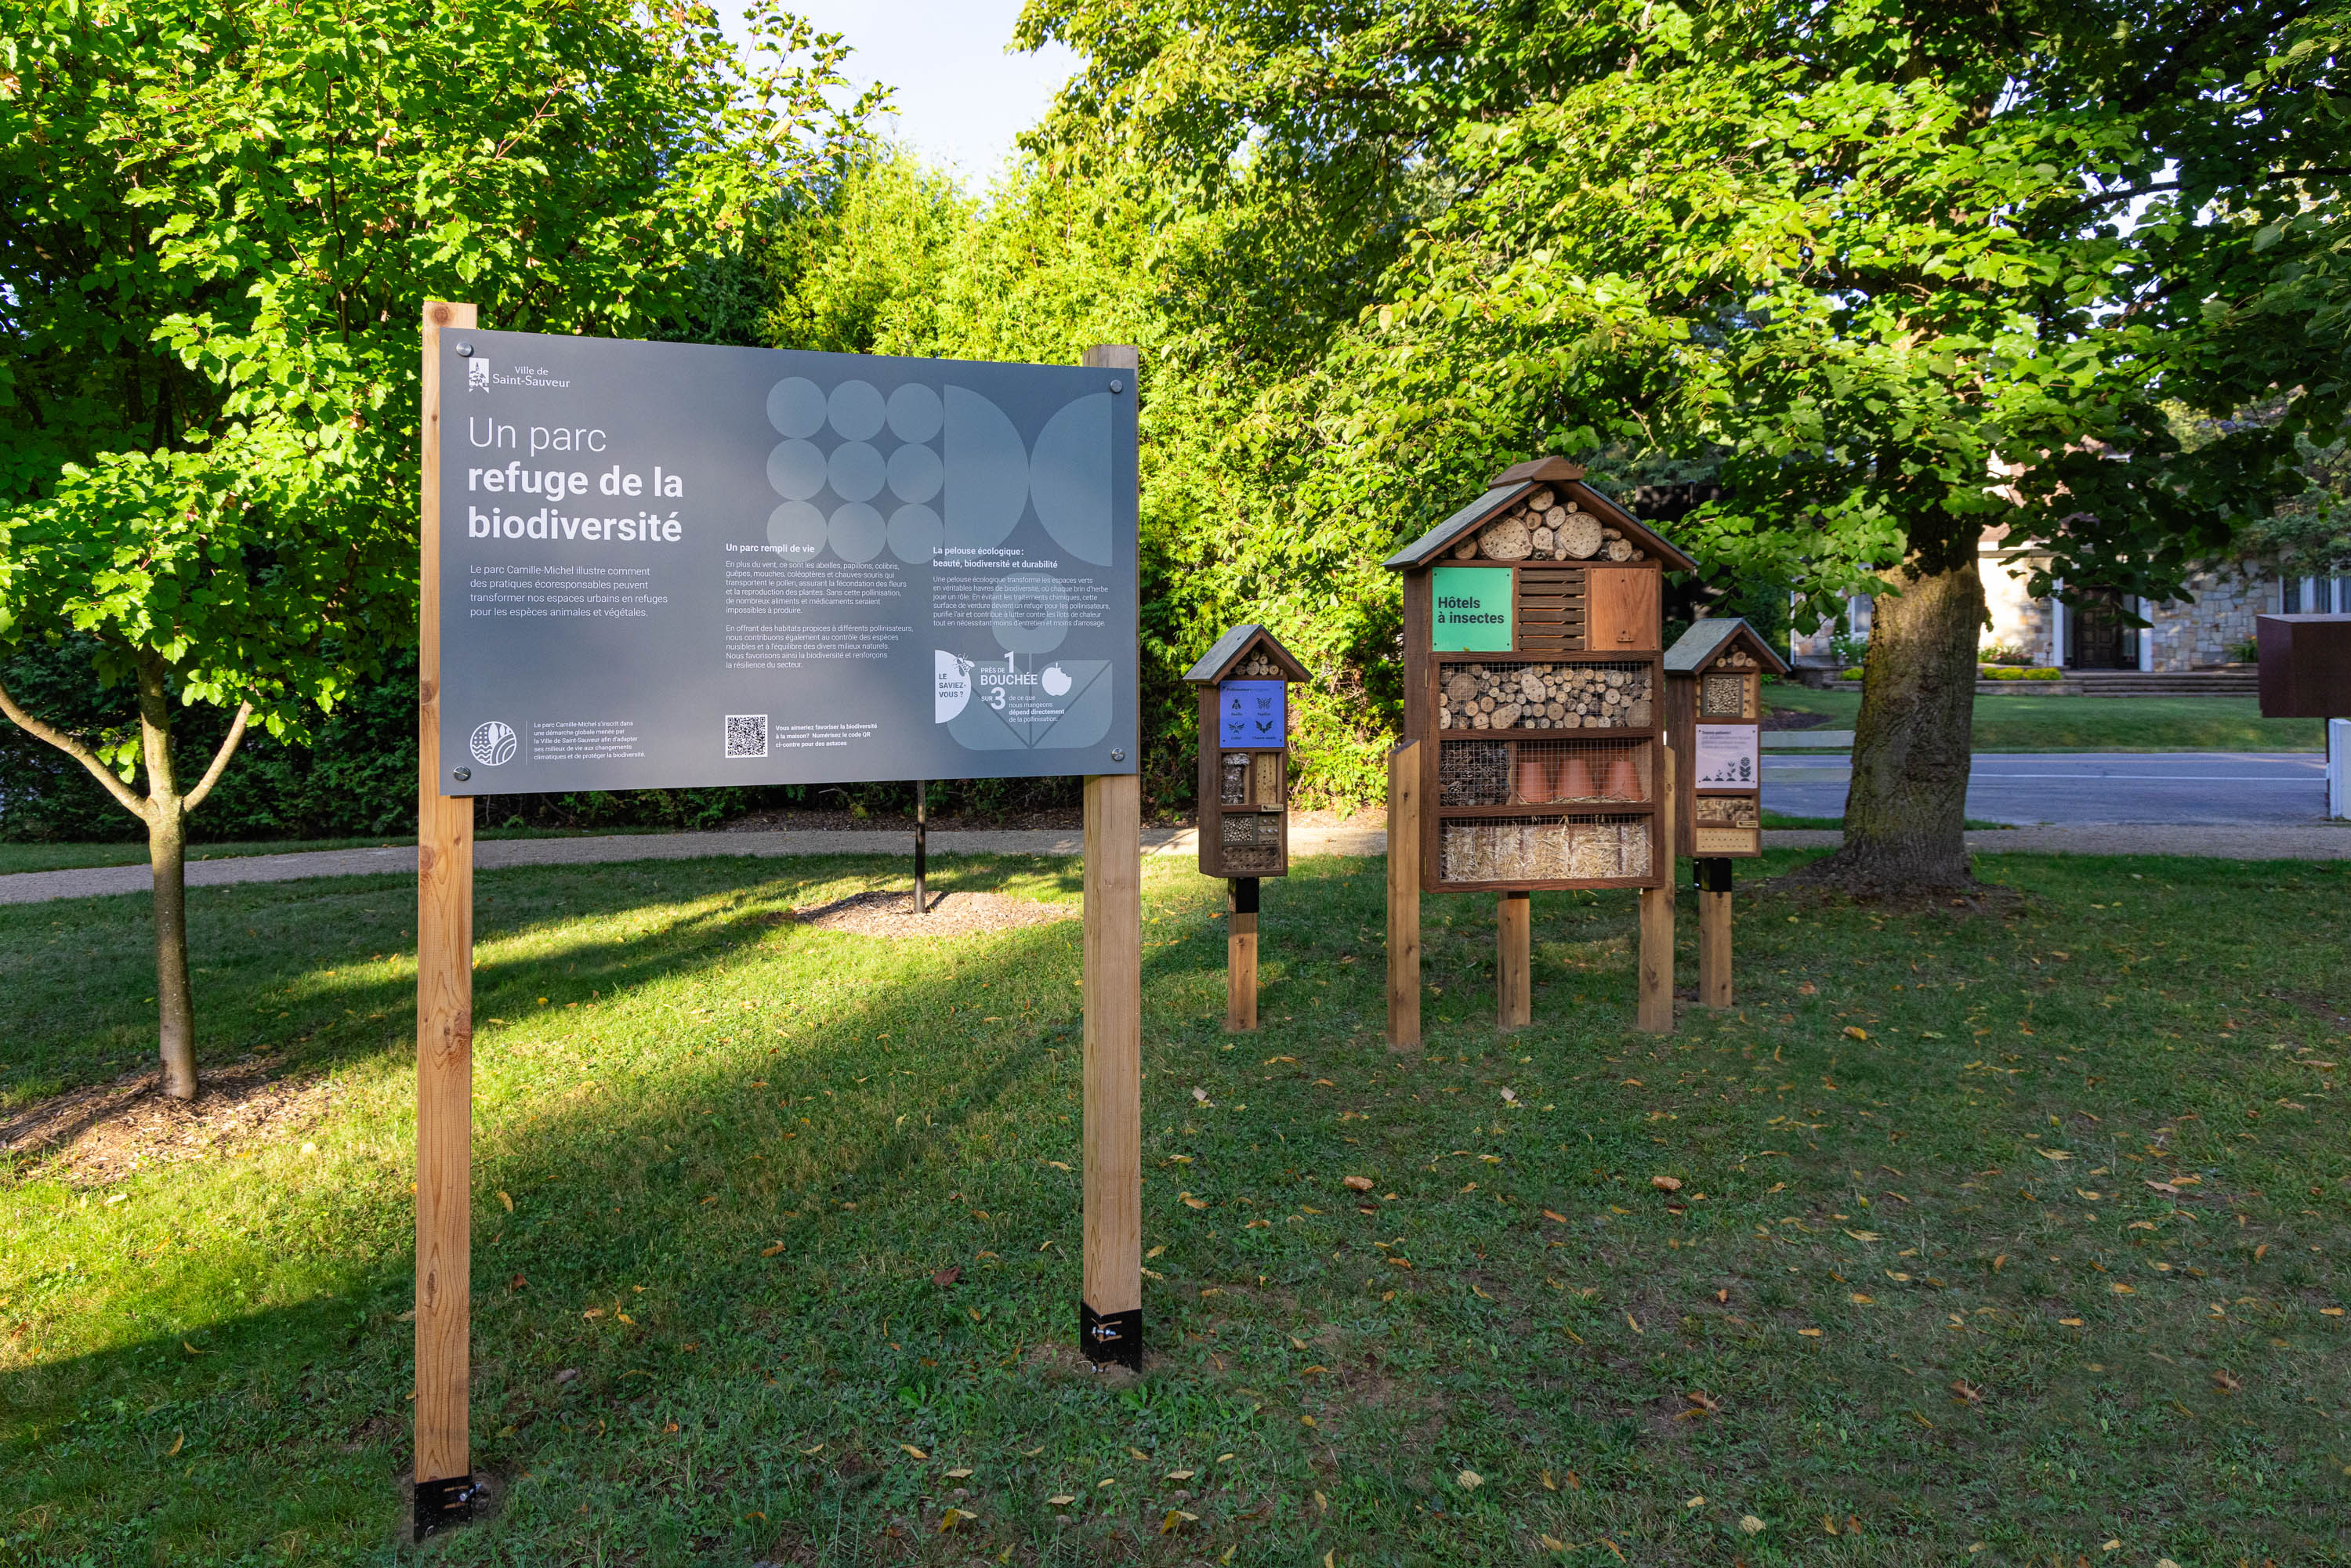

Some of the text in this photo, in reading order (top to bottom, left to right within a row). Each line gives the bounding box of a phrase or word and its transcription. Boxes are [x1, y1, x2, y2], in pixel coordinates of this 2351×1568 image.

[515, 365, 549, 375] Ville de
[493, 373, 571, 388] Saint-Sauveur
[469, 416, 607, 457] Un parc
[469, 462, 683, 502] refuge de la
[469, 506, 682, 541] biodiversité
[761, 544, 788, 554] rempli
[945, 547, 976, 556] pelouse
[736, 561, 751, 569] plus
[843, 562, 874, 571] papillons,
[933, 559, 962, 568] beauté,
[470, 565, 482, 573] Le
[484, 567, 505, 576] parc
[576, 566, 606, 575] illustre
[726, 570, 752, 578] guêpes,
[753, 570, 786, 578] mouches,
[787, 570, 826, 579] coléoptères
[884, 572, 895, 580] qui
[470, 579, 648, 591] des pratiques écoresponsables peuvent
[776, 580, 798, 588] pollen,
[947, 576, 972, 584] pelouse
[972, 576, 1007, 585] écologique
[742, 588, 784, 597] reproduction
[799, 589, 825, 597] plantes.
[862, 589, 902, 598] pollinisation,
[470, 593, 525, 602] transformer
[547, 596, 585, 604] espaces
[587, 594, 620, 603] urbains
[635, 595, 668, 605] refuges
[1438, 596, 1480, 609] Hôtels
[470, 610, 492, 618] pour
[494, 608, 508, 616] les
[510, 608, 548, 618] espèces
[550, 608, 591, 616] animales
[604, 608, 648, 619] végétales.
[726, 607, 766, 615] impossibles
[773, 607, 802, 615] produire.
[1438, 612, 1505, 624] à insectes
[1004, 651, 1014, 673] 1
[981, 672, 1038, 685] BOUCHÉE
[991, 687, 1006, 710] 3
[1023, 715, 1061, 724] pollinisation.
